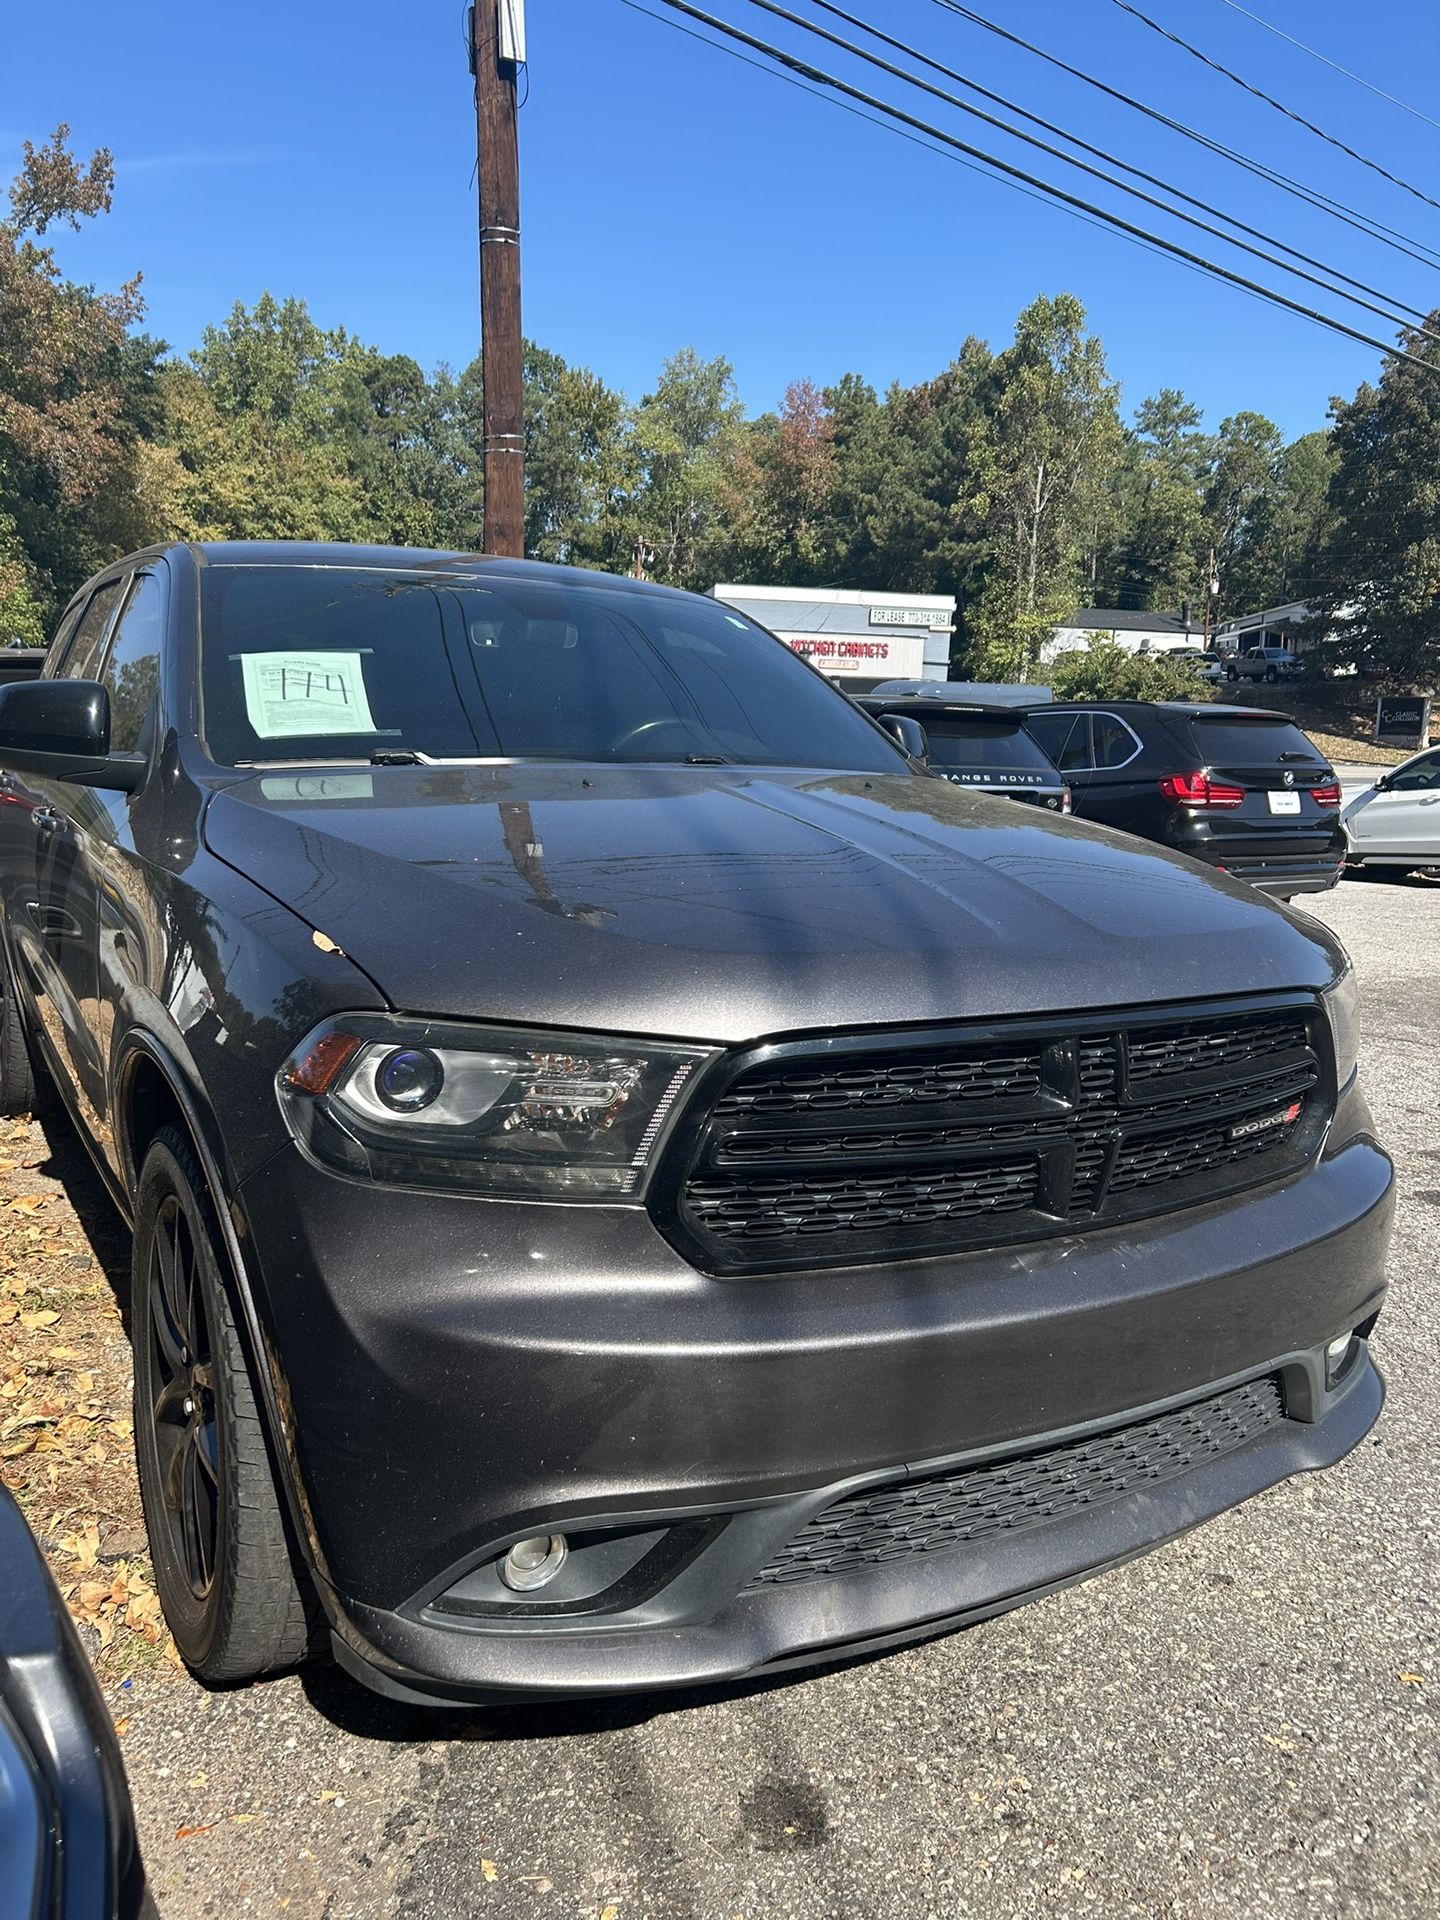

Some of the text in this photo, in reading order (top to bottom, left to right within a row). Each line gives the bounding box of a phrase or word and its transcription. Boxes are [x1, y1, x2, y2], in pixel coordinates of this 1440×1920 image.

[873, 611, 886, 622] FOR
[887, 611, 905, 623] LEASE
[838, 641, 889, 659] CABINETS
[940, 773, 1043, 783] RANGE ROVER
